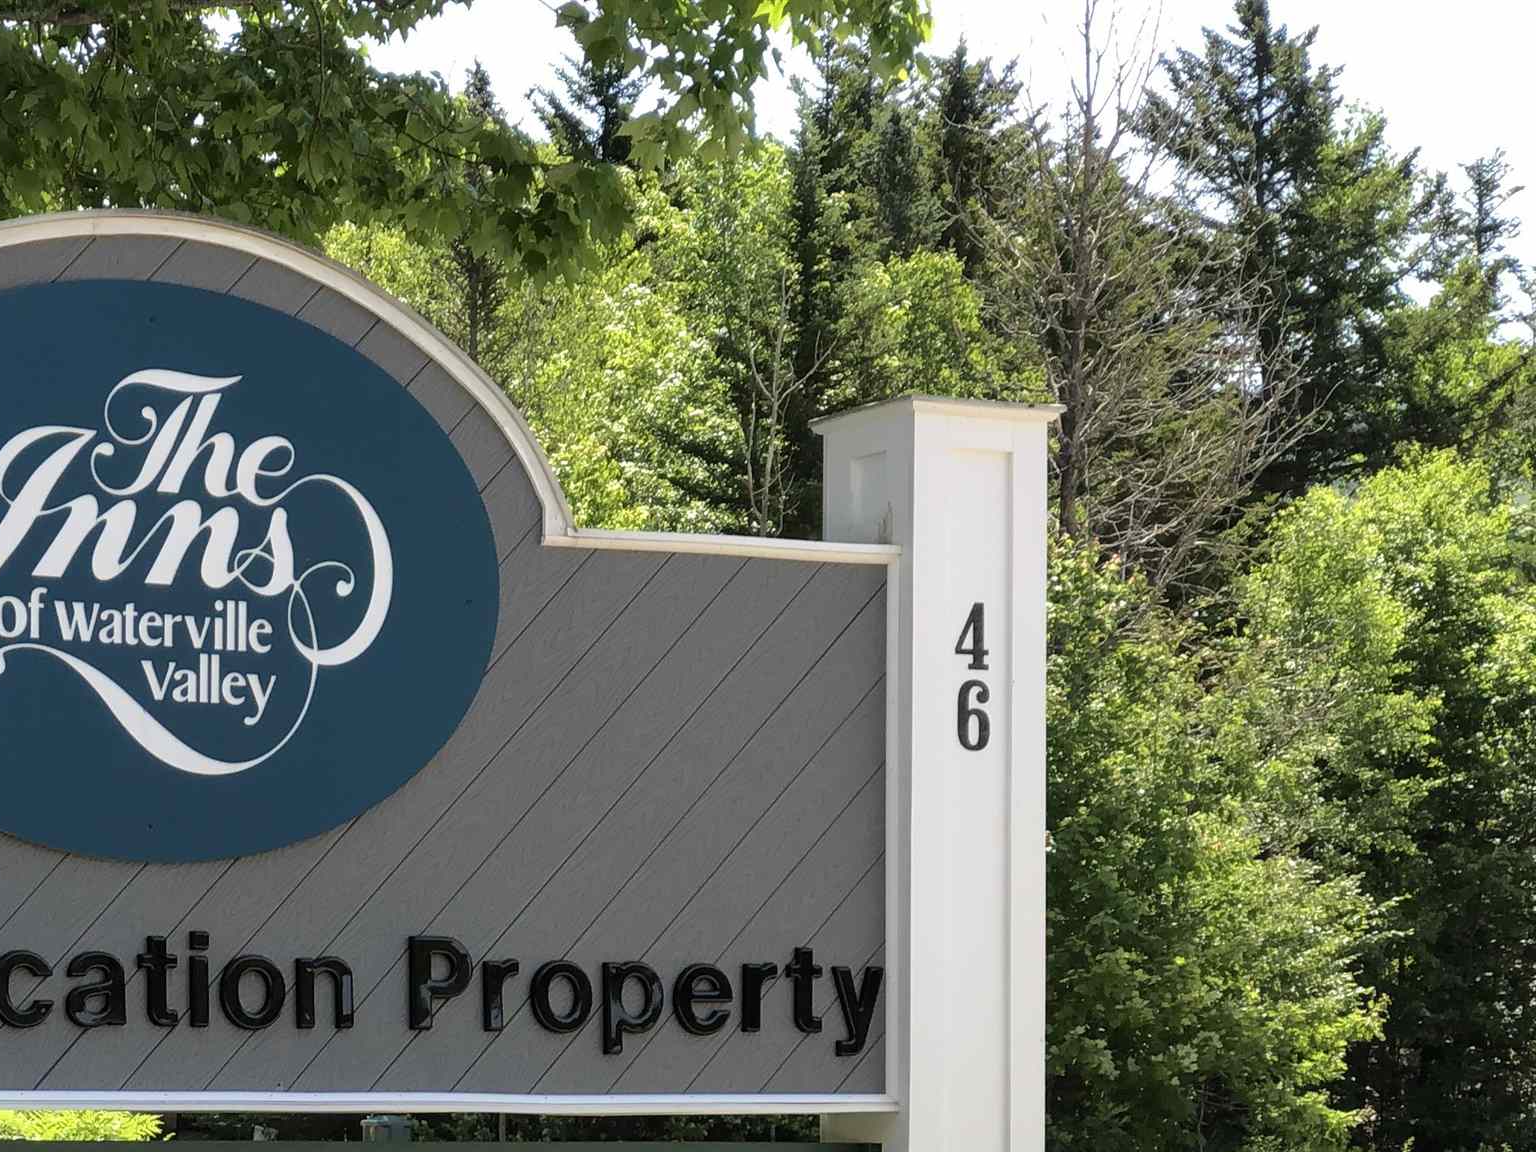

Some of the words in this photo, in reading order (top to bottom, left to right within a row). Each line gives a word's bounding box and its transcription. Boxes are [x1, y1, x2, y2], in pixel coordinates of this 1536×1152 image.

[90, 368, 295, 506] The
[53, 599, 274, 654] Waterville
[140, 653, 278, 726] Valley
[407, 933, 884, 1058] Property
